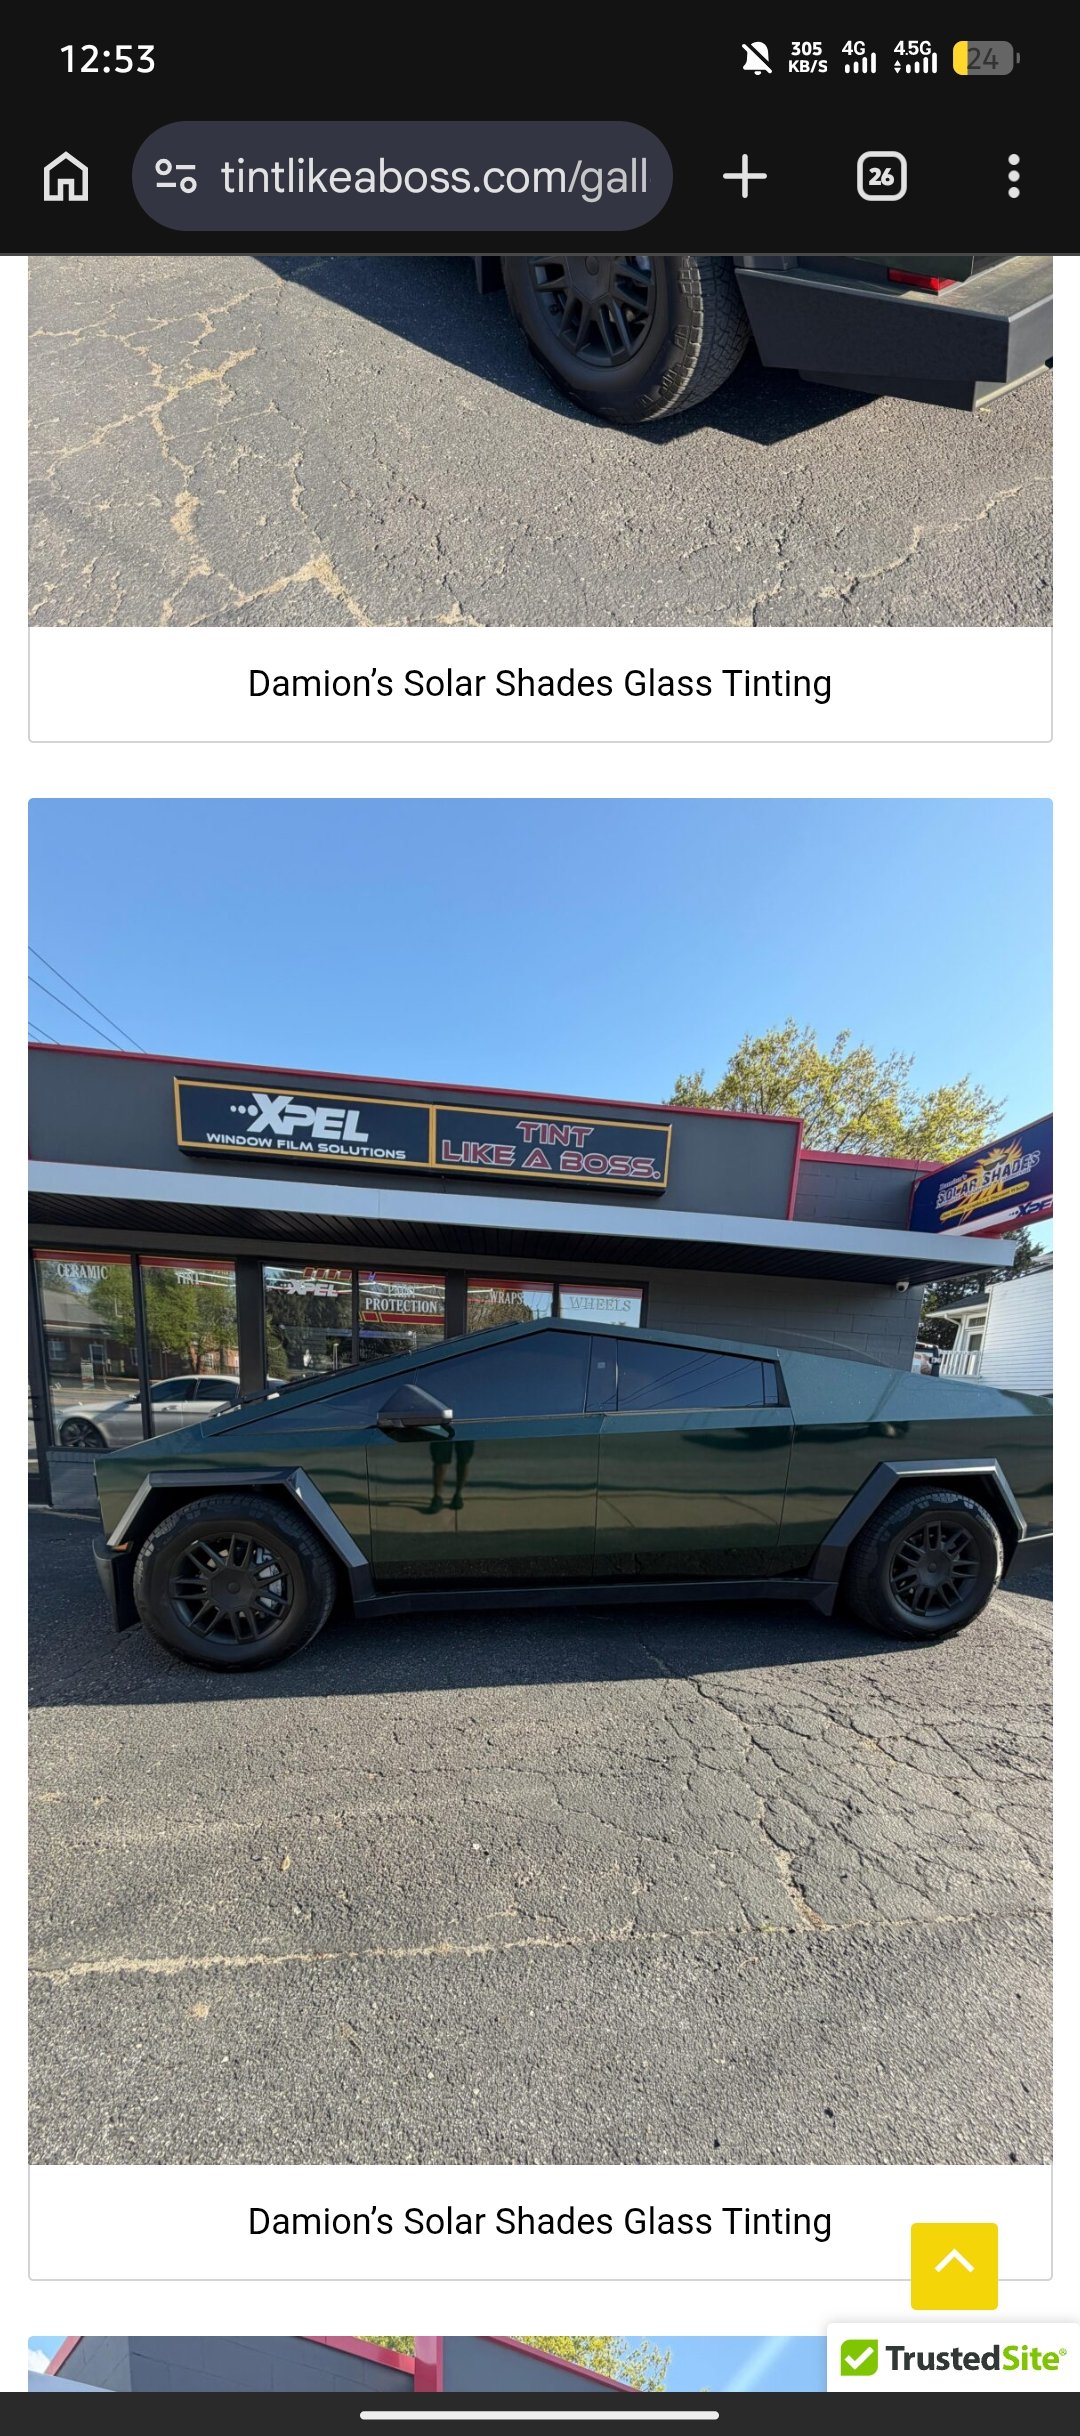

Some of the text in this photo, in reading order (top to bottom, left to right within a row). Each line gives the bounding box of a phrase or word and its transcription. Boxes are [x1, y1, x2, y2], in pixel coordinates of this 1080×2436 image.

[791, 41, 822, 56] 305
[842, 40, 866, 55] 4G
[893, 40, 931, 56] 4.5G
[61, 45, 154, 73] 12:53
[789, 60, 828, 73] KB/S
[967, 47, 999, 70] 24
[221, 158, 647, 203] tintlikeaboss.com/gall
[869, 167, 894, 186] 26
[250, 668, 831, 705] Damion’s Solar Shades Glass Tinting
[247, 1093, 369, 1142] XPEL
[516, 1120, 594, 1148] TINT
[206, 1132, 407, 1160] WINDOW FILM SOLUTIONS
[441, 1140, 516, 1166] LIKE
[521, 1148, 552, 1170] A
[936, 1175, 978, 1207] SOLAR
[981, 1150, 1041, 1187] SHADES
[57, 1263, 108, 1280] CERAMIC
[286, 1279, 338, 1297] XPEL
[489, 1290, 523, 1305] WRAPS
[365, 1298, 438, 1313] PROTECTION
[569, 1296, 632, 1312] WHEELS
[250, 2206, 831, 2243] Damion’s Solar Shades Glass Tinting
